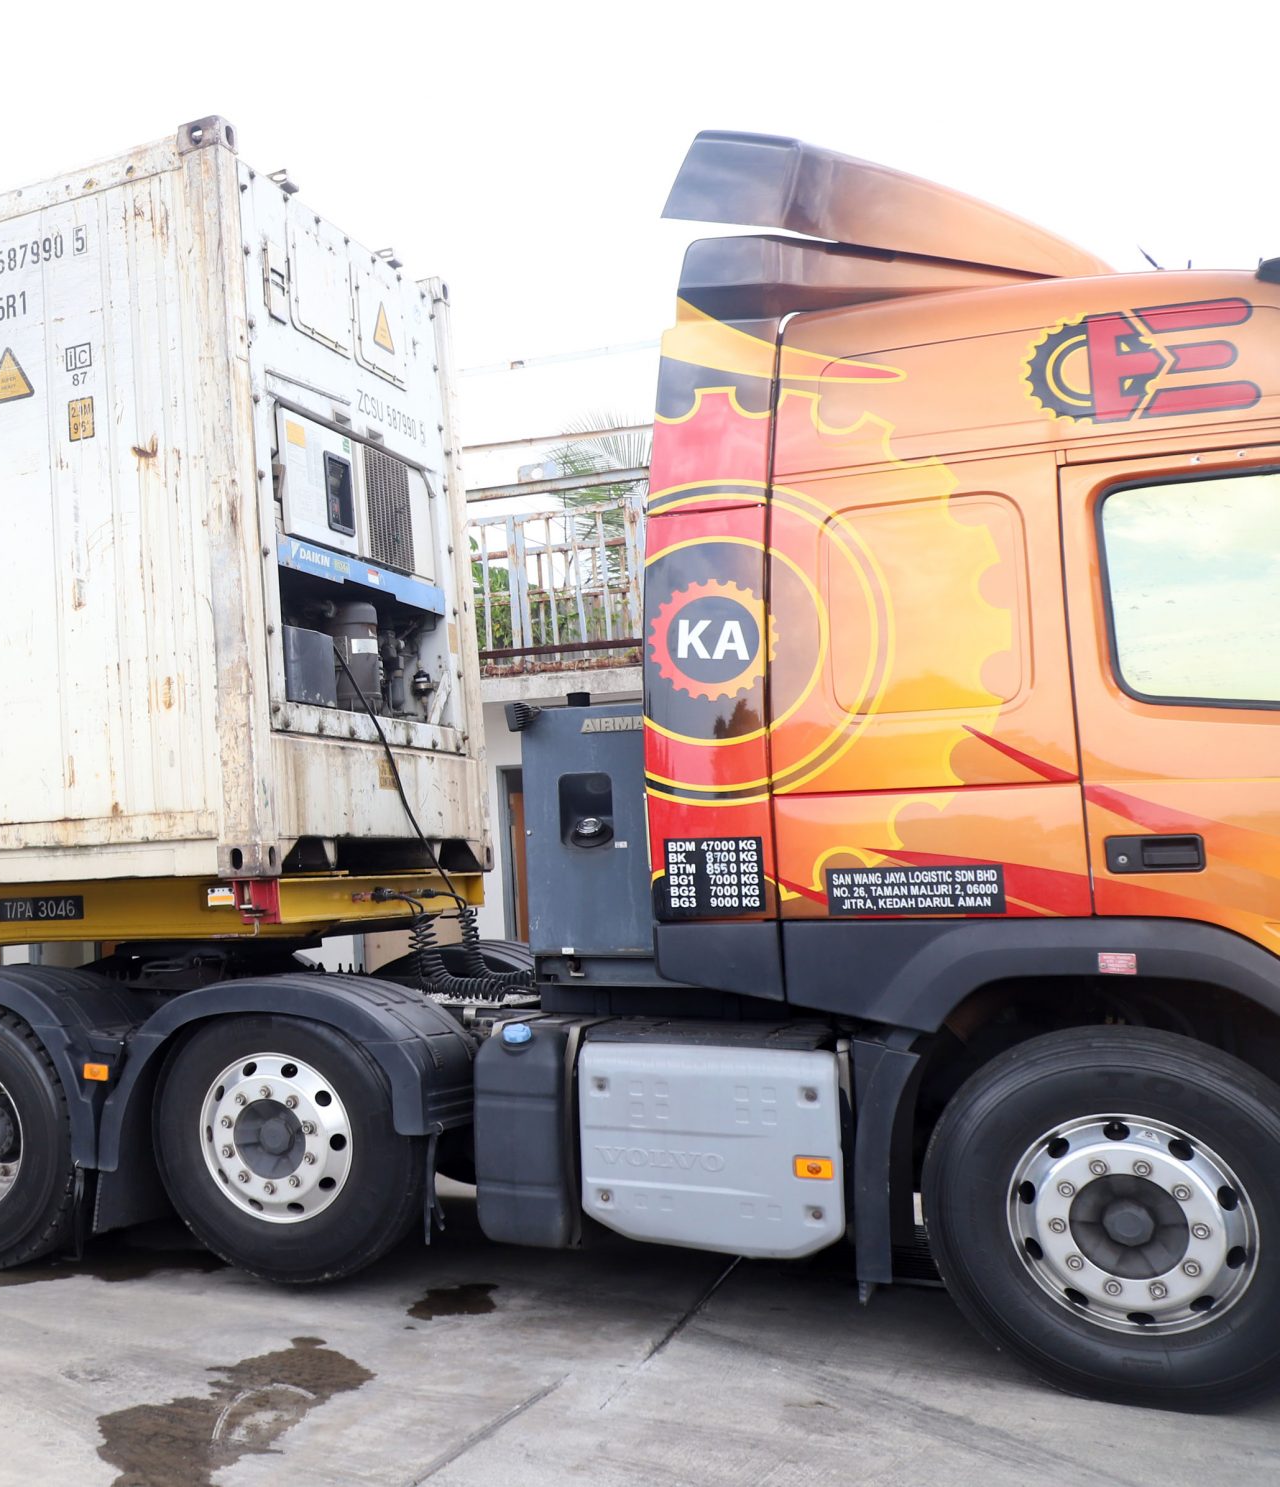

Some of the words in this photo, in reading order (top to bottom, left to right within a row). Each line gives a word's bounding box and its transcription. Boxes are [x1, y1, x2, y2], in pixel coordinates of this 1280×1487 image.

[74, 226, 86, 254] 5
[72, 371, 88, 386] 87
[356, 388, 384, 422] ZCSU
[386, 405, 417, 440] 587990
[299, 548, 331, 568] DAIKIN
[676, 619, 750, 661] KA
[668, 841, 696, 852] BDM
[701, 841, 736, 851] 47000
[739, 840, 757, 850] KG
[669, 853, 687, 863] BK
[739, 851, 758, 861] KG
[669, 864, 696, 874] BTM
[740, 863, 758, 873] KG
[669, 875, 694, 885] BG1
[709, 875, 738, 884] 7000
[741, 874, 759, 884] KG
[832, 873, 852, 885] SAN
[853, 872, 882, 884] WANG
[884, 872, 907, 884] JAYA
[909, 871, 953, 883] LOGISTIC
[955, 870, 975, 882] SDN
[976, 869, 998, 881] BHD
[670, 886, 696, 896] BG2
[710, 886, 739, 896] 7000
[741, 885, 760, 895] KG
[833, 887, 851, 897] NO.
[853, 886, 868, 898] 26,
[870, 885, 908, 896] TAMAN
[910, 884, 952, 895] MALURI
[955, 884, 965, 896] 2,
[966, 884, 998, 895] 06000
[38, 900, 76, 918] 3046
[671, 897, 697, 907] BG3
[710, 897, 739, 907] 9000
[742, 897, 760, 907] KG
[842, 898, 877, 910] JITRA,
[878, 897, 915, 908] KEDAH
[917, 897, 955, 907] DARUL
[957, 896, 992, 907] AMAN
[594, 1145, 725, 1173] VOLVO
